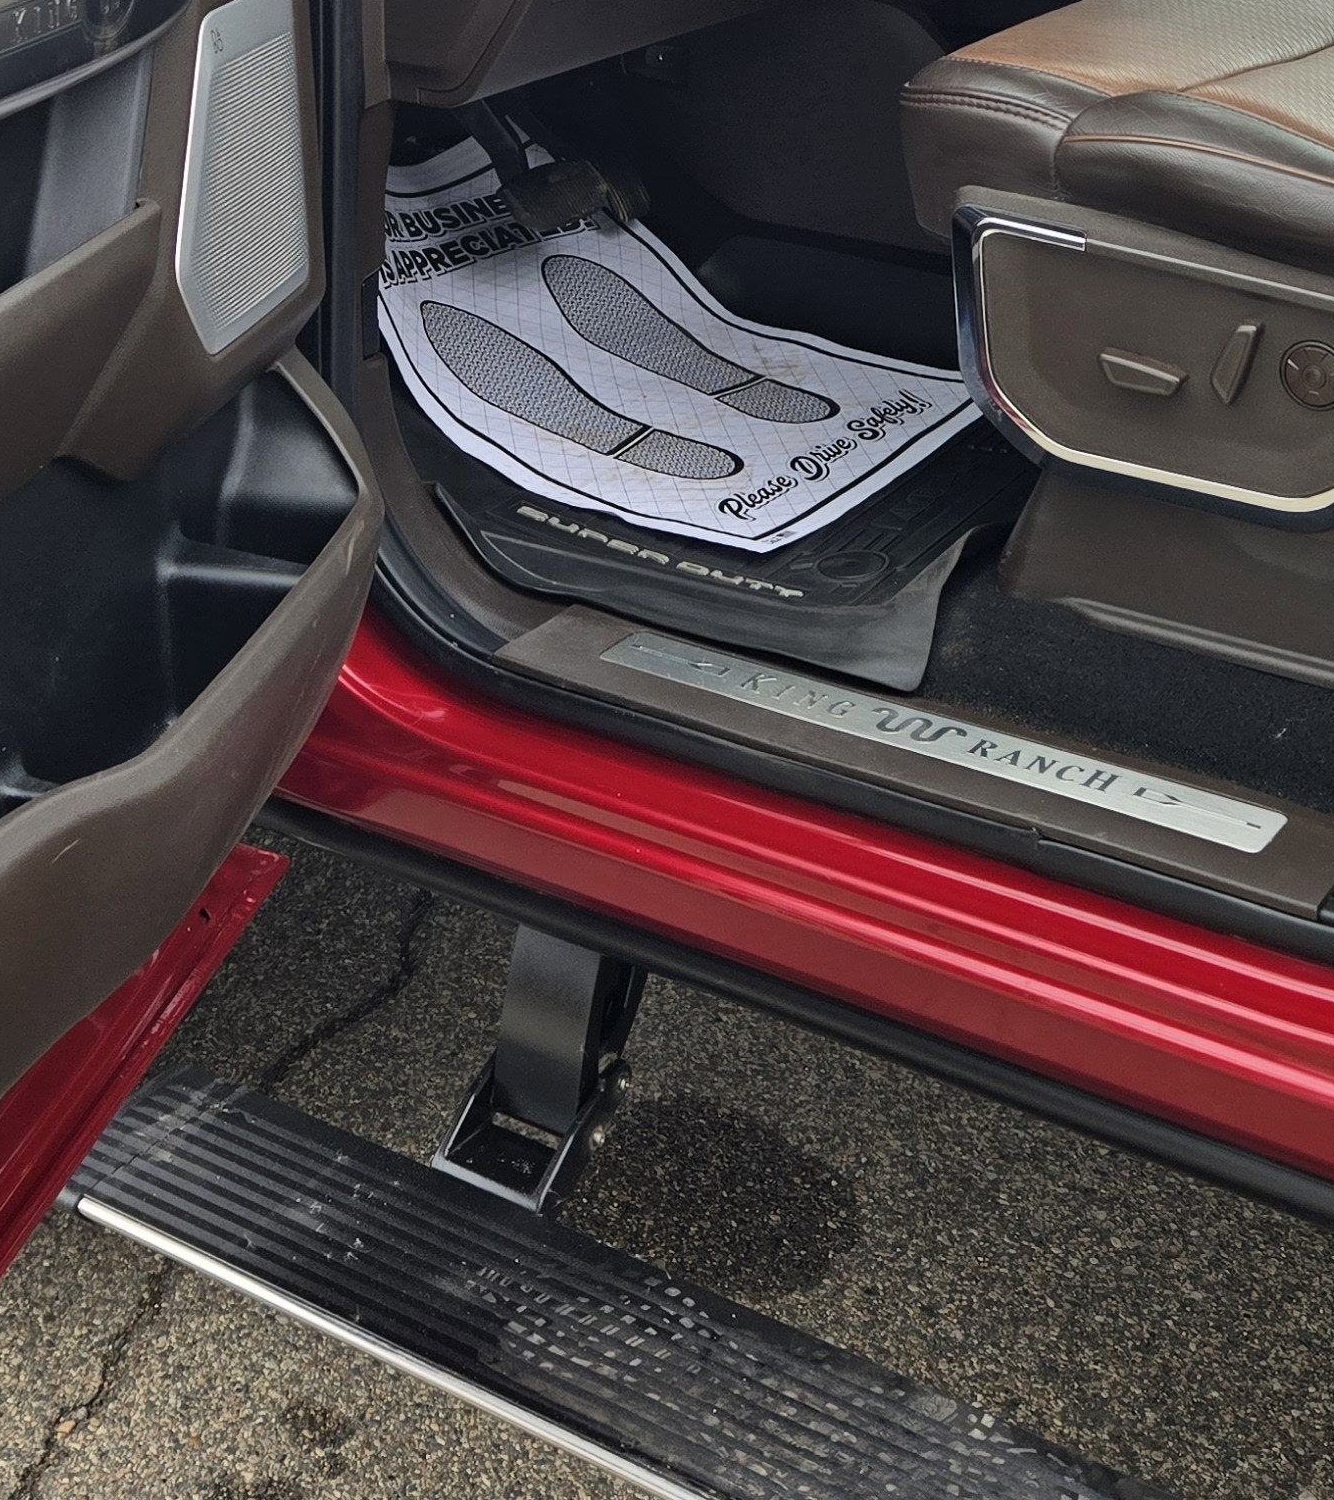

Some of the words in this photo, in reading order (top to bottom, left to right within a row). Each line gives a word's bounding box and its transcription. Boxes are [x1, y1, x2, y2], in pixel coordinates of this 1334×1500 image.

[391, 215, 601, 286] APPRECIAT
[717, 474, 798, 521] Please
[789, 438, 857, 483] Drive
[515, 505, 670, 566] SUPER
[676, 560, 805, 598] DUTY
[738, 671, 857, 719] KING
[966, 737, 1122, 795] RANCH
